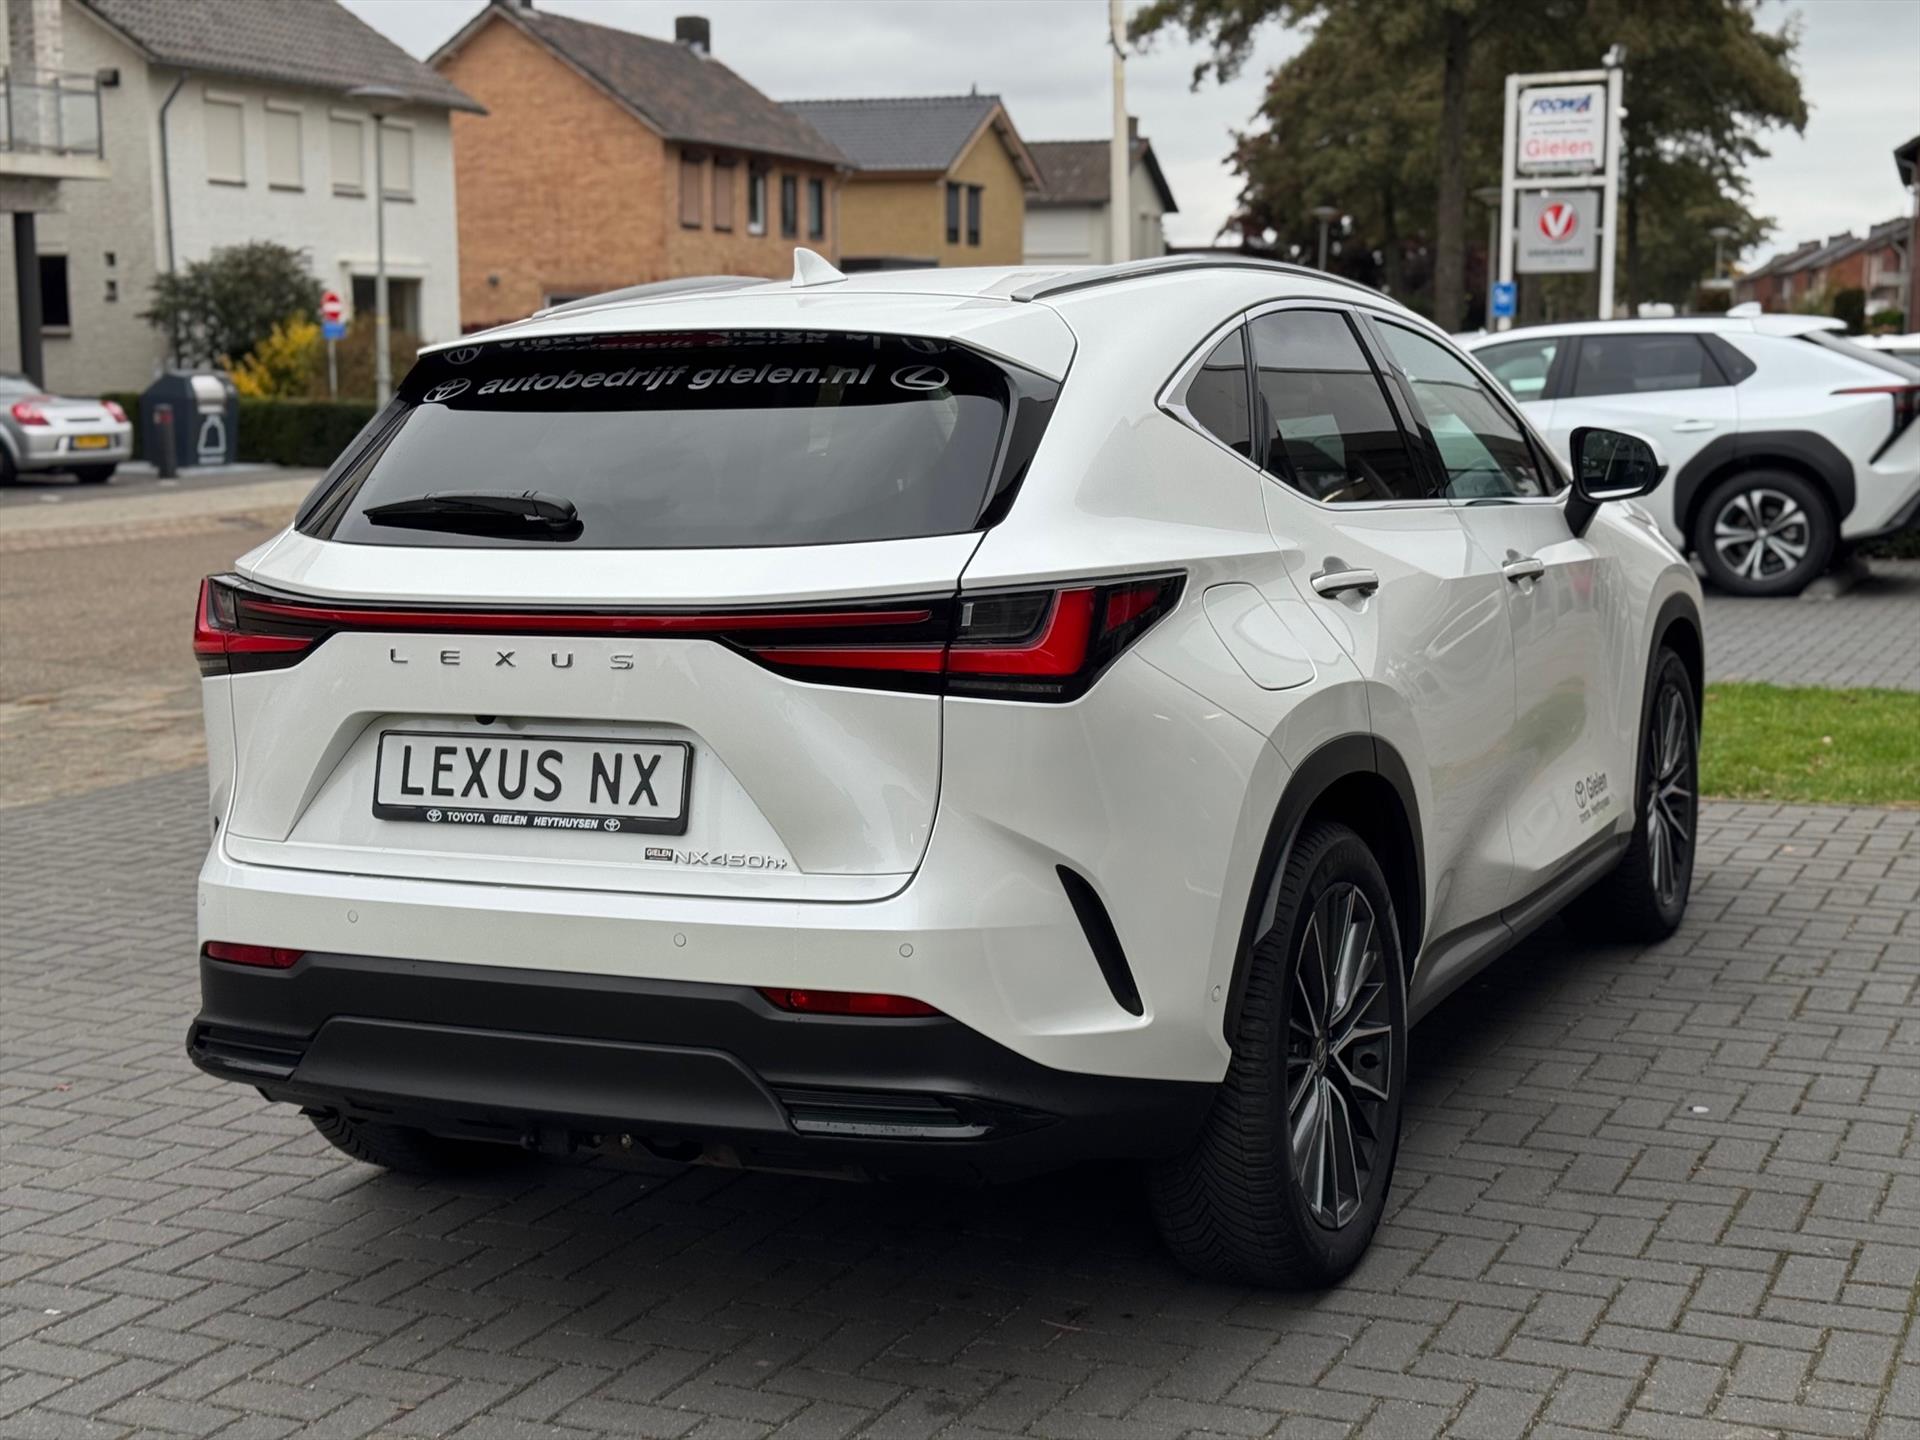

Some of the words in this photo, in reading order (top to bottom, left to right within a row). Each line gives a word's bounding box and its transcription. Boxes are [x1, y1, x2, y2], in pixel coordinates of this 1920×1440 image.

[1527, 139, 1593, 157] Gielen
[478, 365, 689, 396] autobedrijf
[688, 364, 877, 390] gielen.nl
[389, 648, 635, 670] LEXUS
[400, 745, 564, 801] LEXUS
[589, 752, 662, 806] NX
[446, 811, 486, 823] TOYOTA
[492, 814, 528, 825] GIELEN
[533, 816, 599, 829] HEYTHUYSEN
[646, 848, 672, 857] GIELEN
[674, 850, 788, 870] NX450h+
